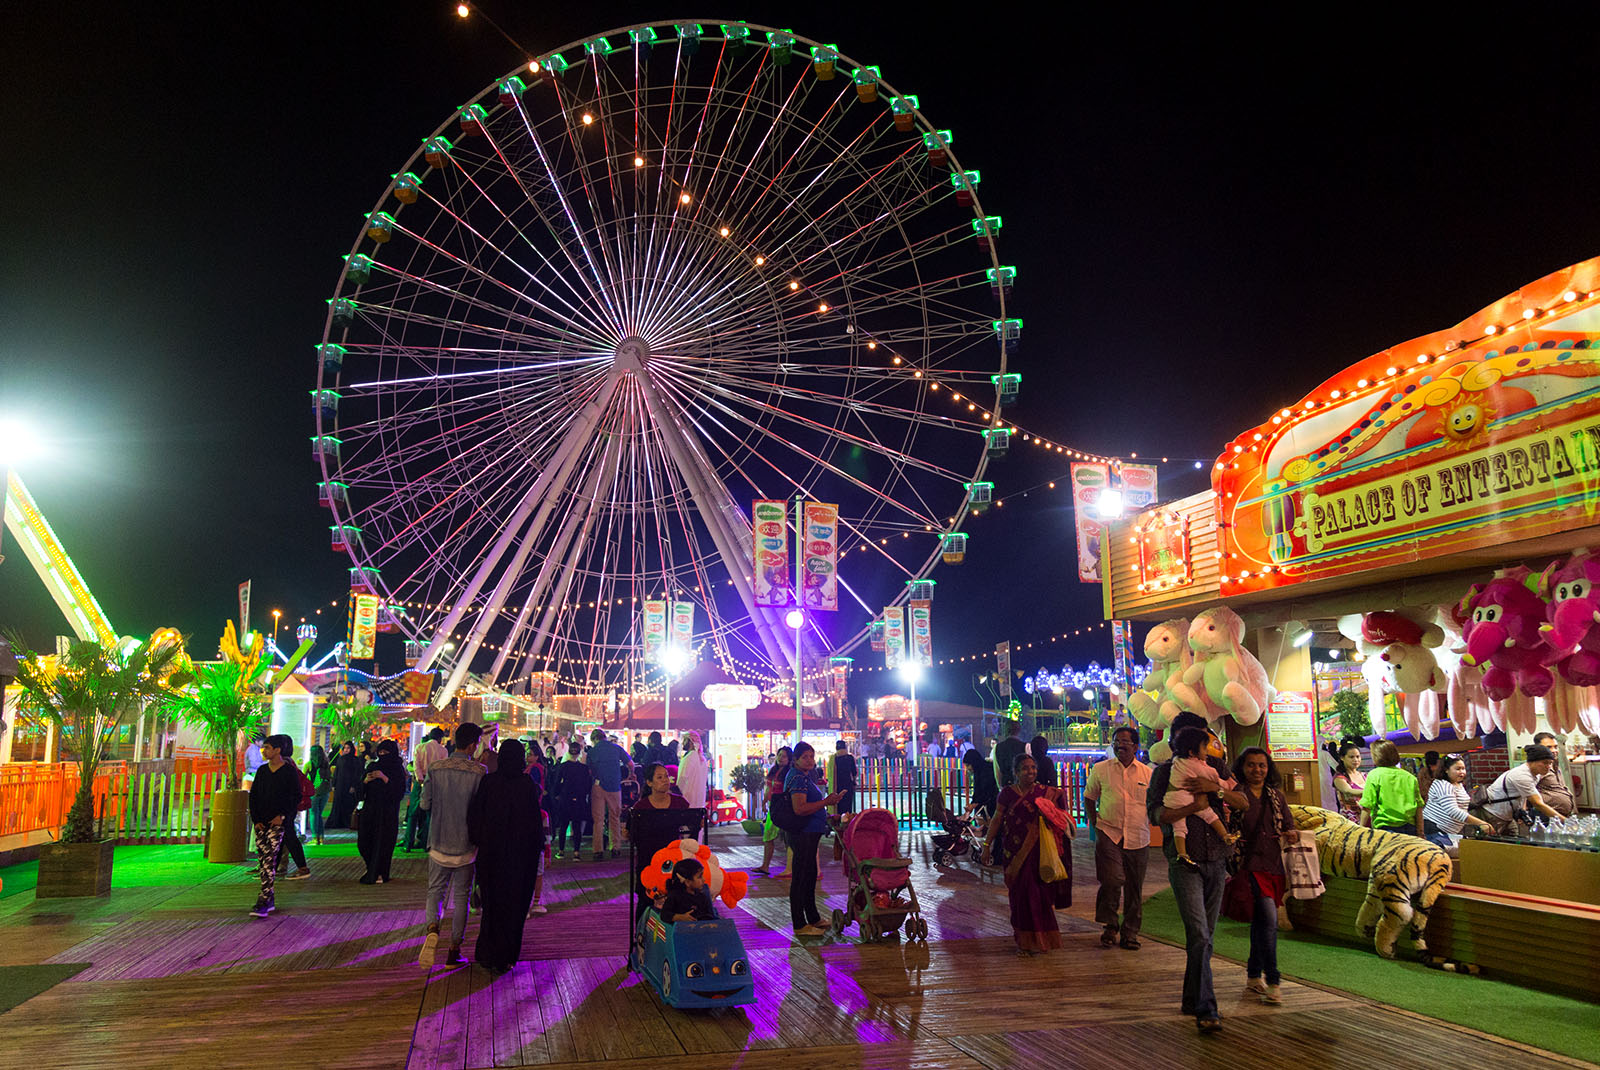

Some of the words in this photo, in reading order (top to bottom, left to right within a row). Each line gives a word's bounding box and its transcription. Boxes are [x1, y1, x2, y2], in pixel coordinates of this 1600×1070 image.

[1312, 485, 1396, 538] PALACE
[1401, 474, 1431, 516] OF
[761, 524, 780, 534] 欢迎
